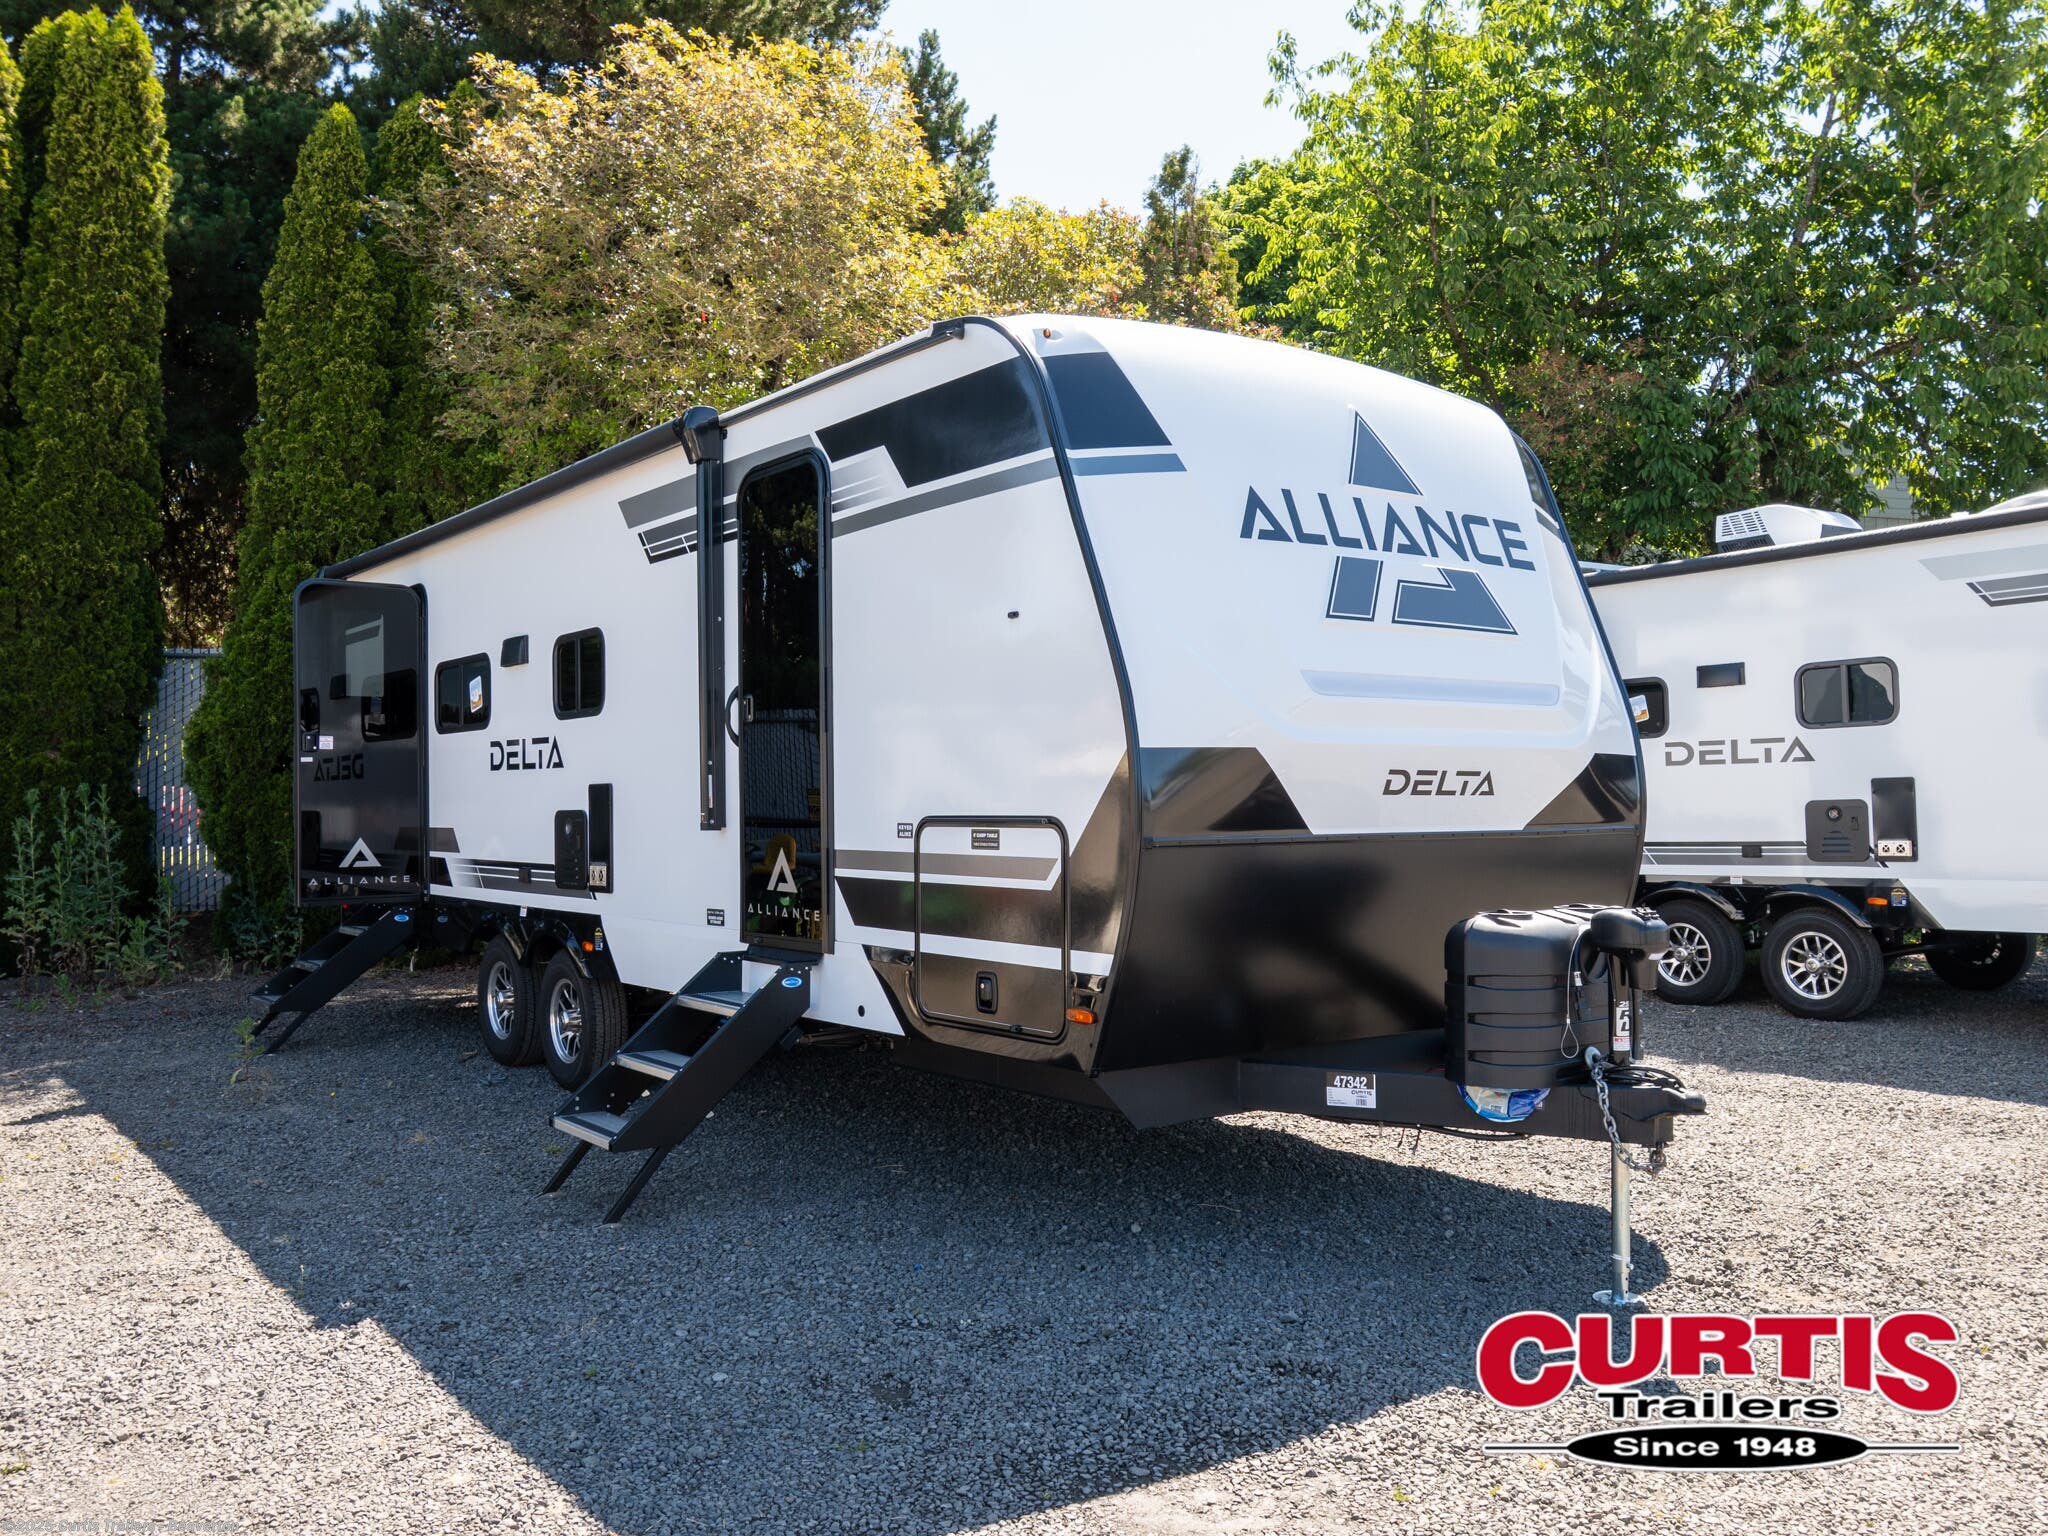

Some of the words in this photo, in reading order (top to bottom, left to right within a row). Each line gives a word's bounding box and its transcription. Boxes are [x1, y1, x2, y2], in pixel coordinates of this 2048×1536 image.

[1240, 484, 1537, 571] ALLIANCE
[489, 736, 564, 771] DELTA
[1664, 735, 1816, 766] DELTA
[1382, 769, 1495, 796] DELTA
[308, 875, 411, 886] ALLIANCE
[747, 903, 820, 922] ALLIANCE
[1333, 1075, 1367, 1089] 47342
